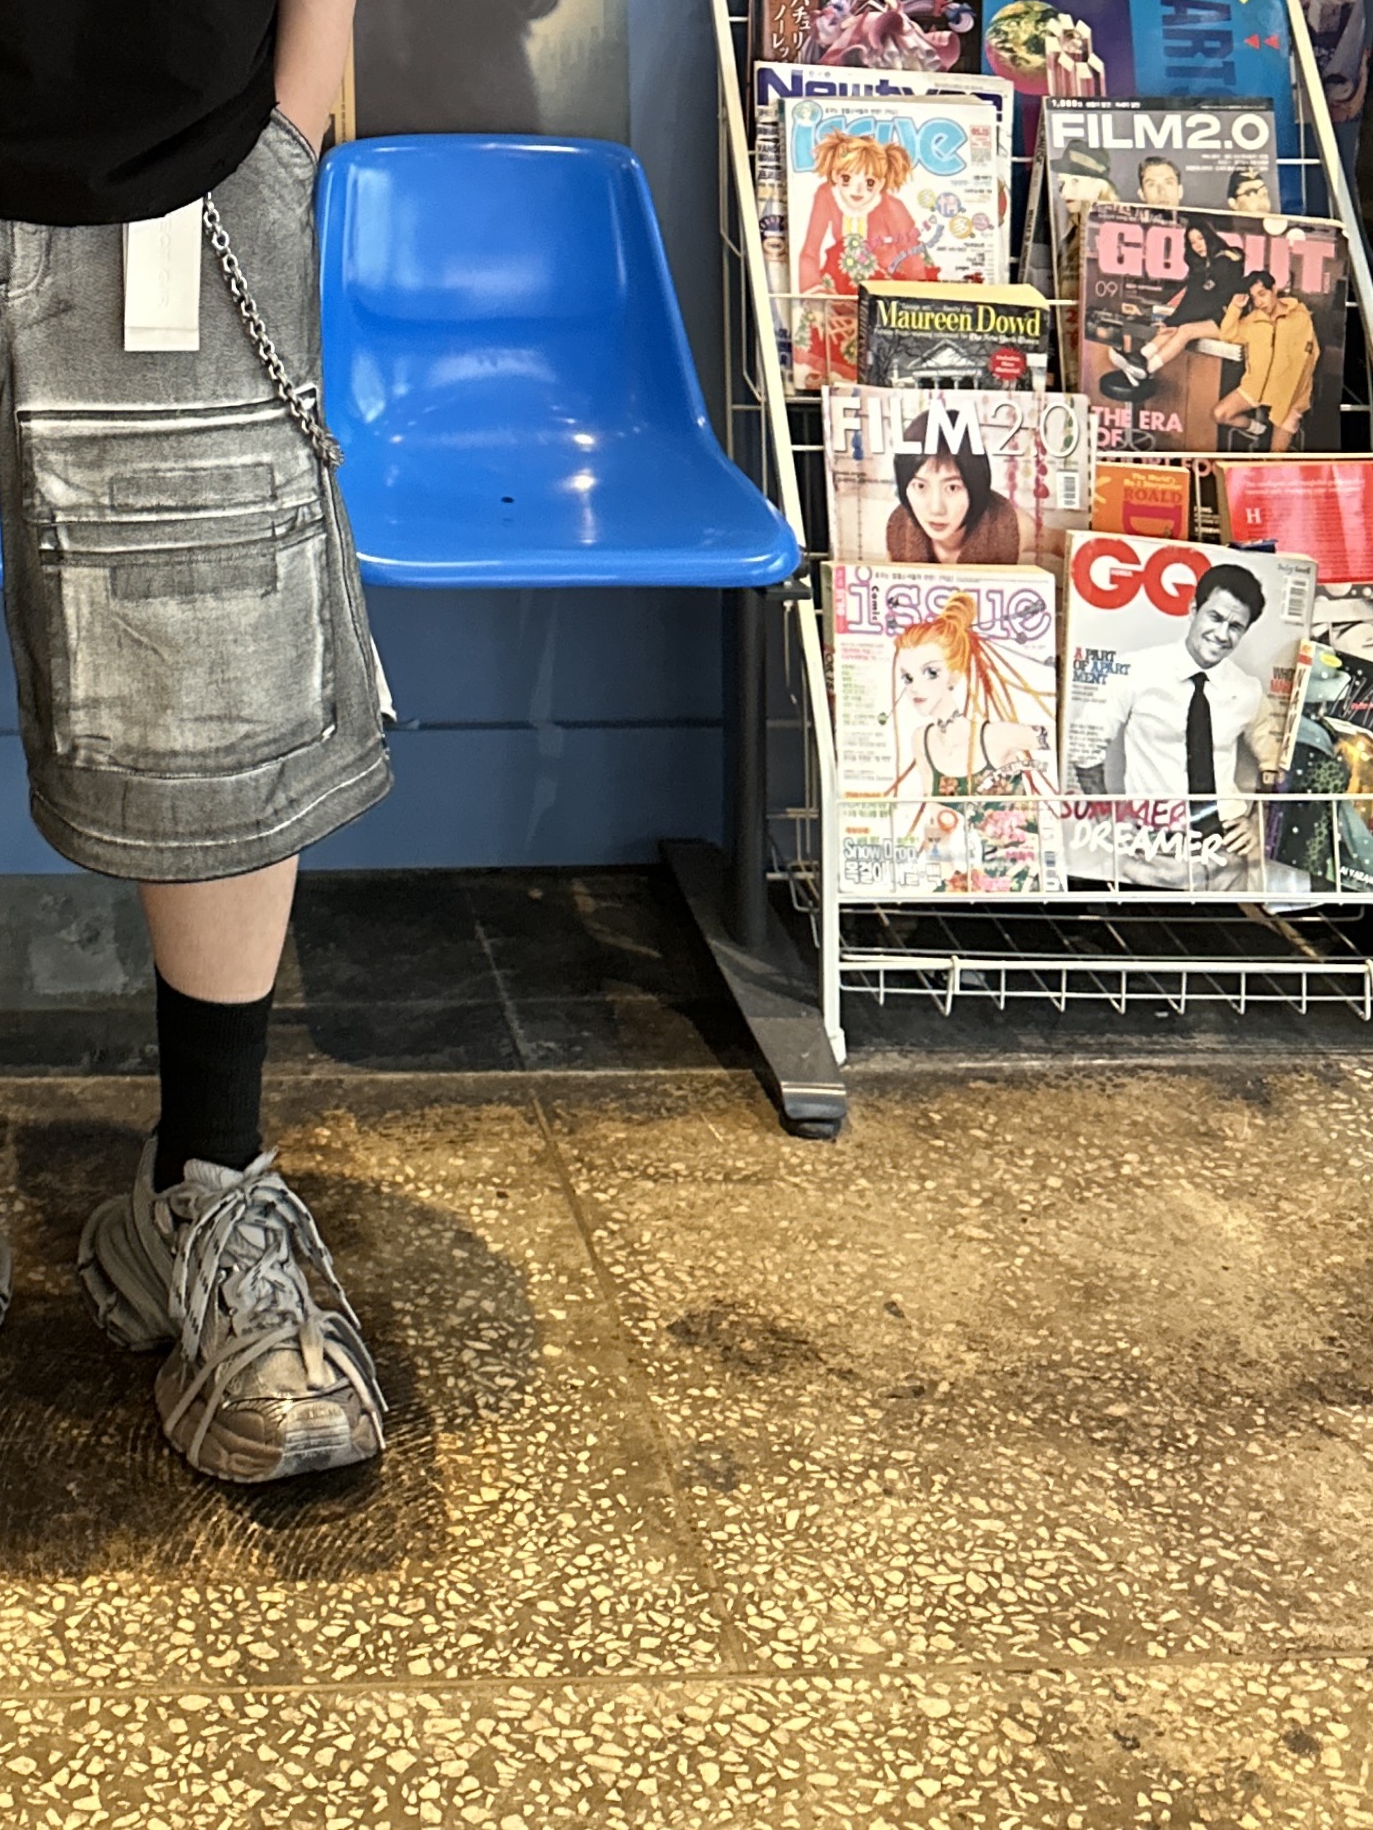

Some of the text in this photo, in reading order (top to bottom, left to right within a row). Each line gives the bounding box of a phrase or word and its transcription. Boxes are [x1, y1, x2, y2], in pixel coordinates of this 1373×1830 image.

[1052, 114, 1269, 150] FILM2.0
[1098, 221, 1189, 280] GO
[1095, 281, 1118, 297] 09
[877, 300, 1040, 337] Maureen Dowd
[1092, 406, 1183, 433] THE ERA
[1096, 428, 1123, 447] OF
[1123, 487, 1183, 504] ROALD
[1246, 508, 1262, 524] H
[1072, 538, 1212, 617] GQ
[871, 585, 880, 620] Comic
[1075, 647, 1116, 662] A PART
[1073, 659, 1131, 676] OF APART
[1073, 672, 1108, 685] MENT
[1070, 821, 1228, 867] DREAMER
